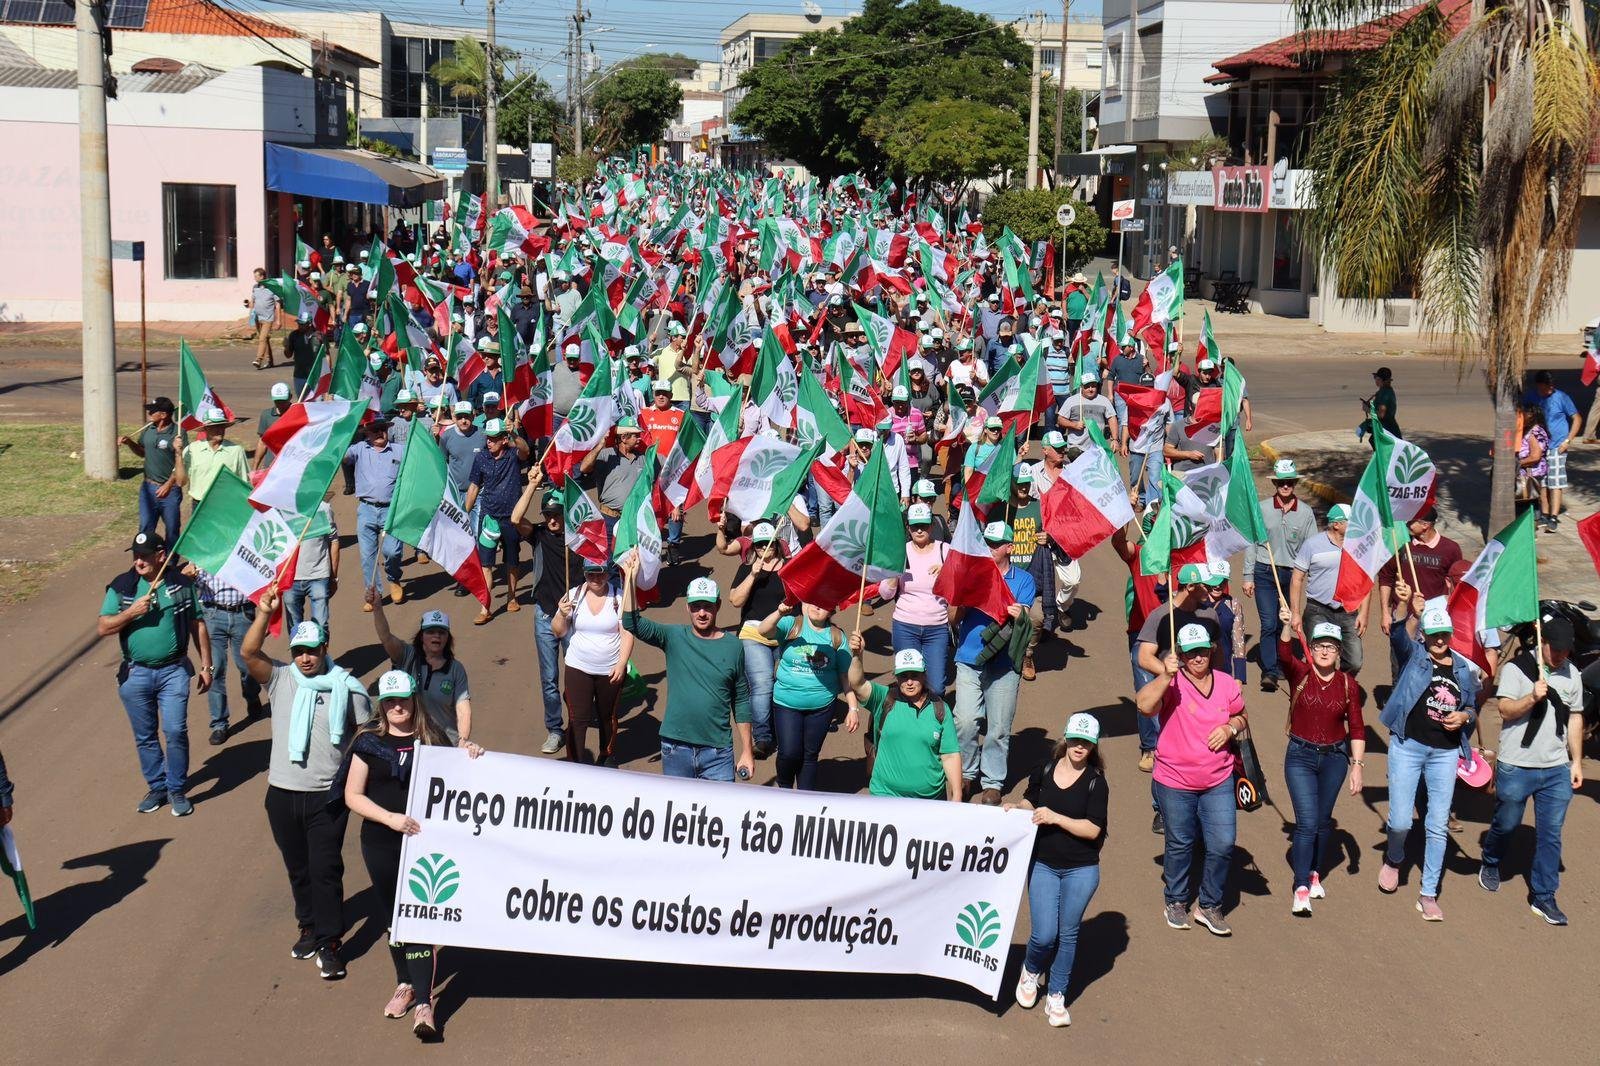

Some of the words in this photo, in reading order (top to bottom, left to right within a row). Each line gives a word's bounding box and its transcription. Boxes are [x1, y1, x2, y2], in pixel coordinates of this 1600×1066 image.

[237, 544, 275, 580] FETAG-RS
[425, 777, 505, 836] Preço
[513, 787, 613, 836] mínimo
[623, 797, 654, 840] do
[663, 801, 729, 859] leite,
[741, 811, 783, 854] tão
[792, 807, 898, 866] MÍNIMO
[906, 839, 954, 879] que
[961, 836, 1009, 874] não
[398, 904, 462, 922] FETAG-RS
[506, 879, 583, 923] cobre
[592, 896, 623, 927] os
[632, 895, 721, 935] custos
[730, 900, 762, 937] de
[768, 907, 898, 953] produção.
[944, 944, 999, 972] FETAG-RS
